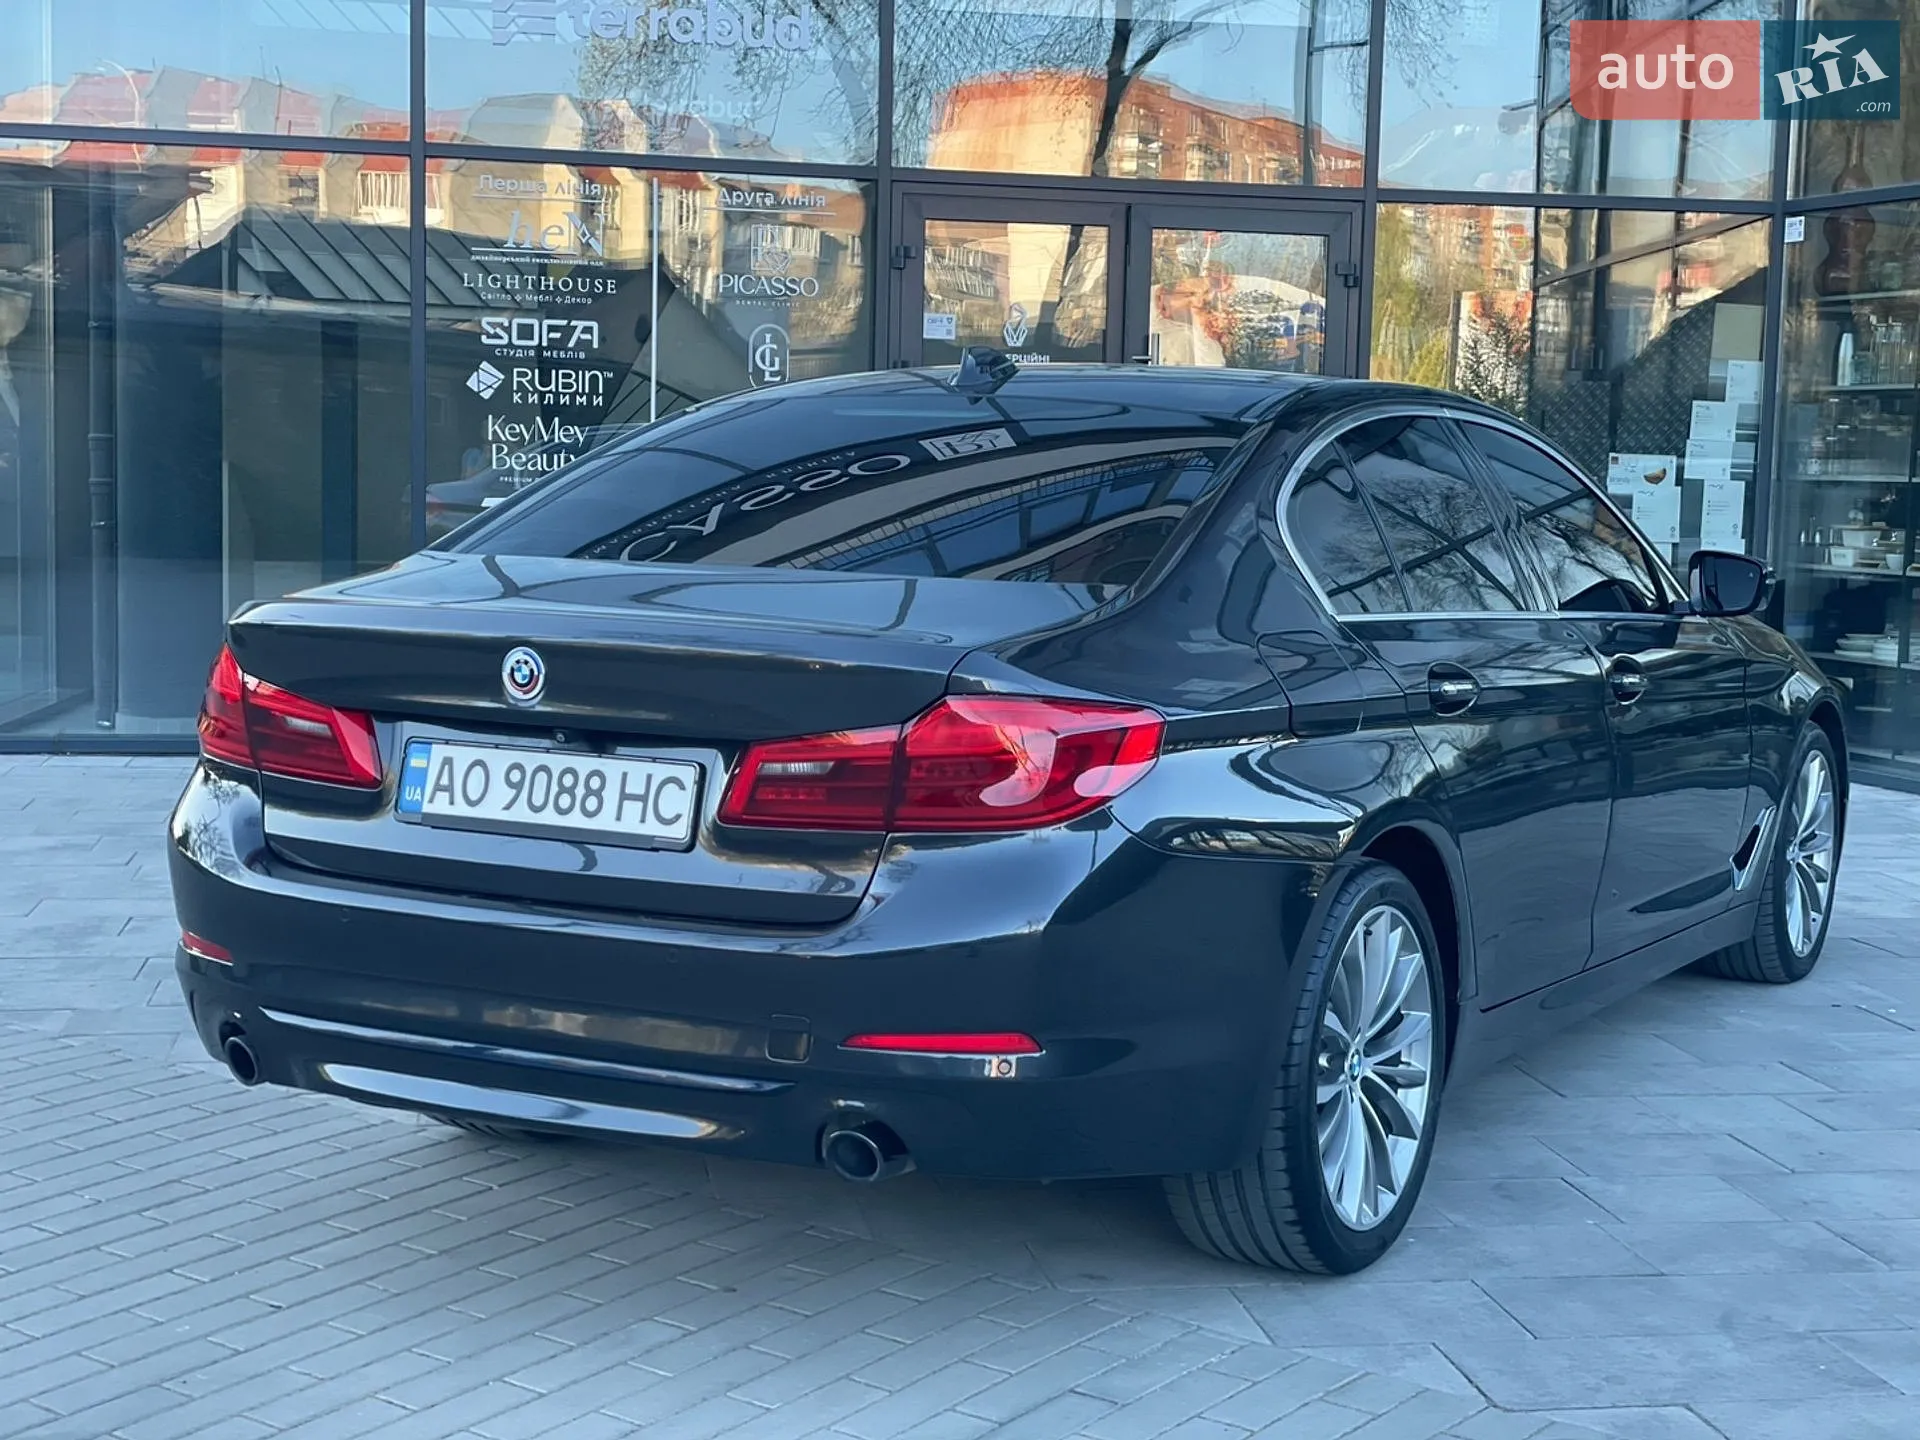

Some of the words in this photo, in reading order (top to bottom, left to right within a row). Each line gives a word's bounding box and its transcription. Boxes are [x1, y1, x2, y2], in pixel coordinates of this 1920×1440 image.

[572, 0, 810, 50] terrabud
[480, 174, 547, 194] Перша
[555, 179, 601, 196] лінія
[719, 187, 775, 207] Друга
[781, 190, 826, 207] лінія
[463, 272, 617, 295] LIGHTHOUSE
[718, 273, 820, 298] PICASSO
[480, 316, 599, 349] SOFA
[494, 348, 535, 358] СТУДІЯ
[543, 350, 586, 360] МЕБЛІВ
[512, 367, 603, 394] RUBIN
[513, 392, 603, 407] КИЛИМИ
[487, 414, 589, 448] KeyMey
[405, 785, 423, 801] UA
[428, 756, 490, 808] AO
[501, 761, 607, 818] 9088
[615, 771, 687, 827] HC
